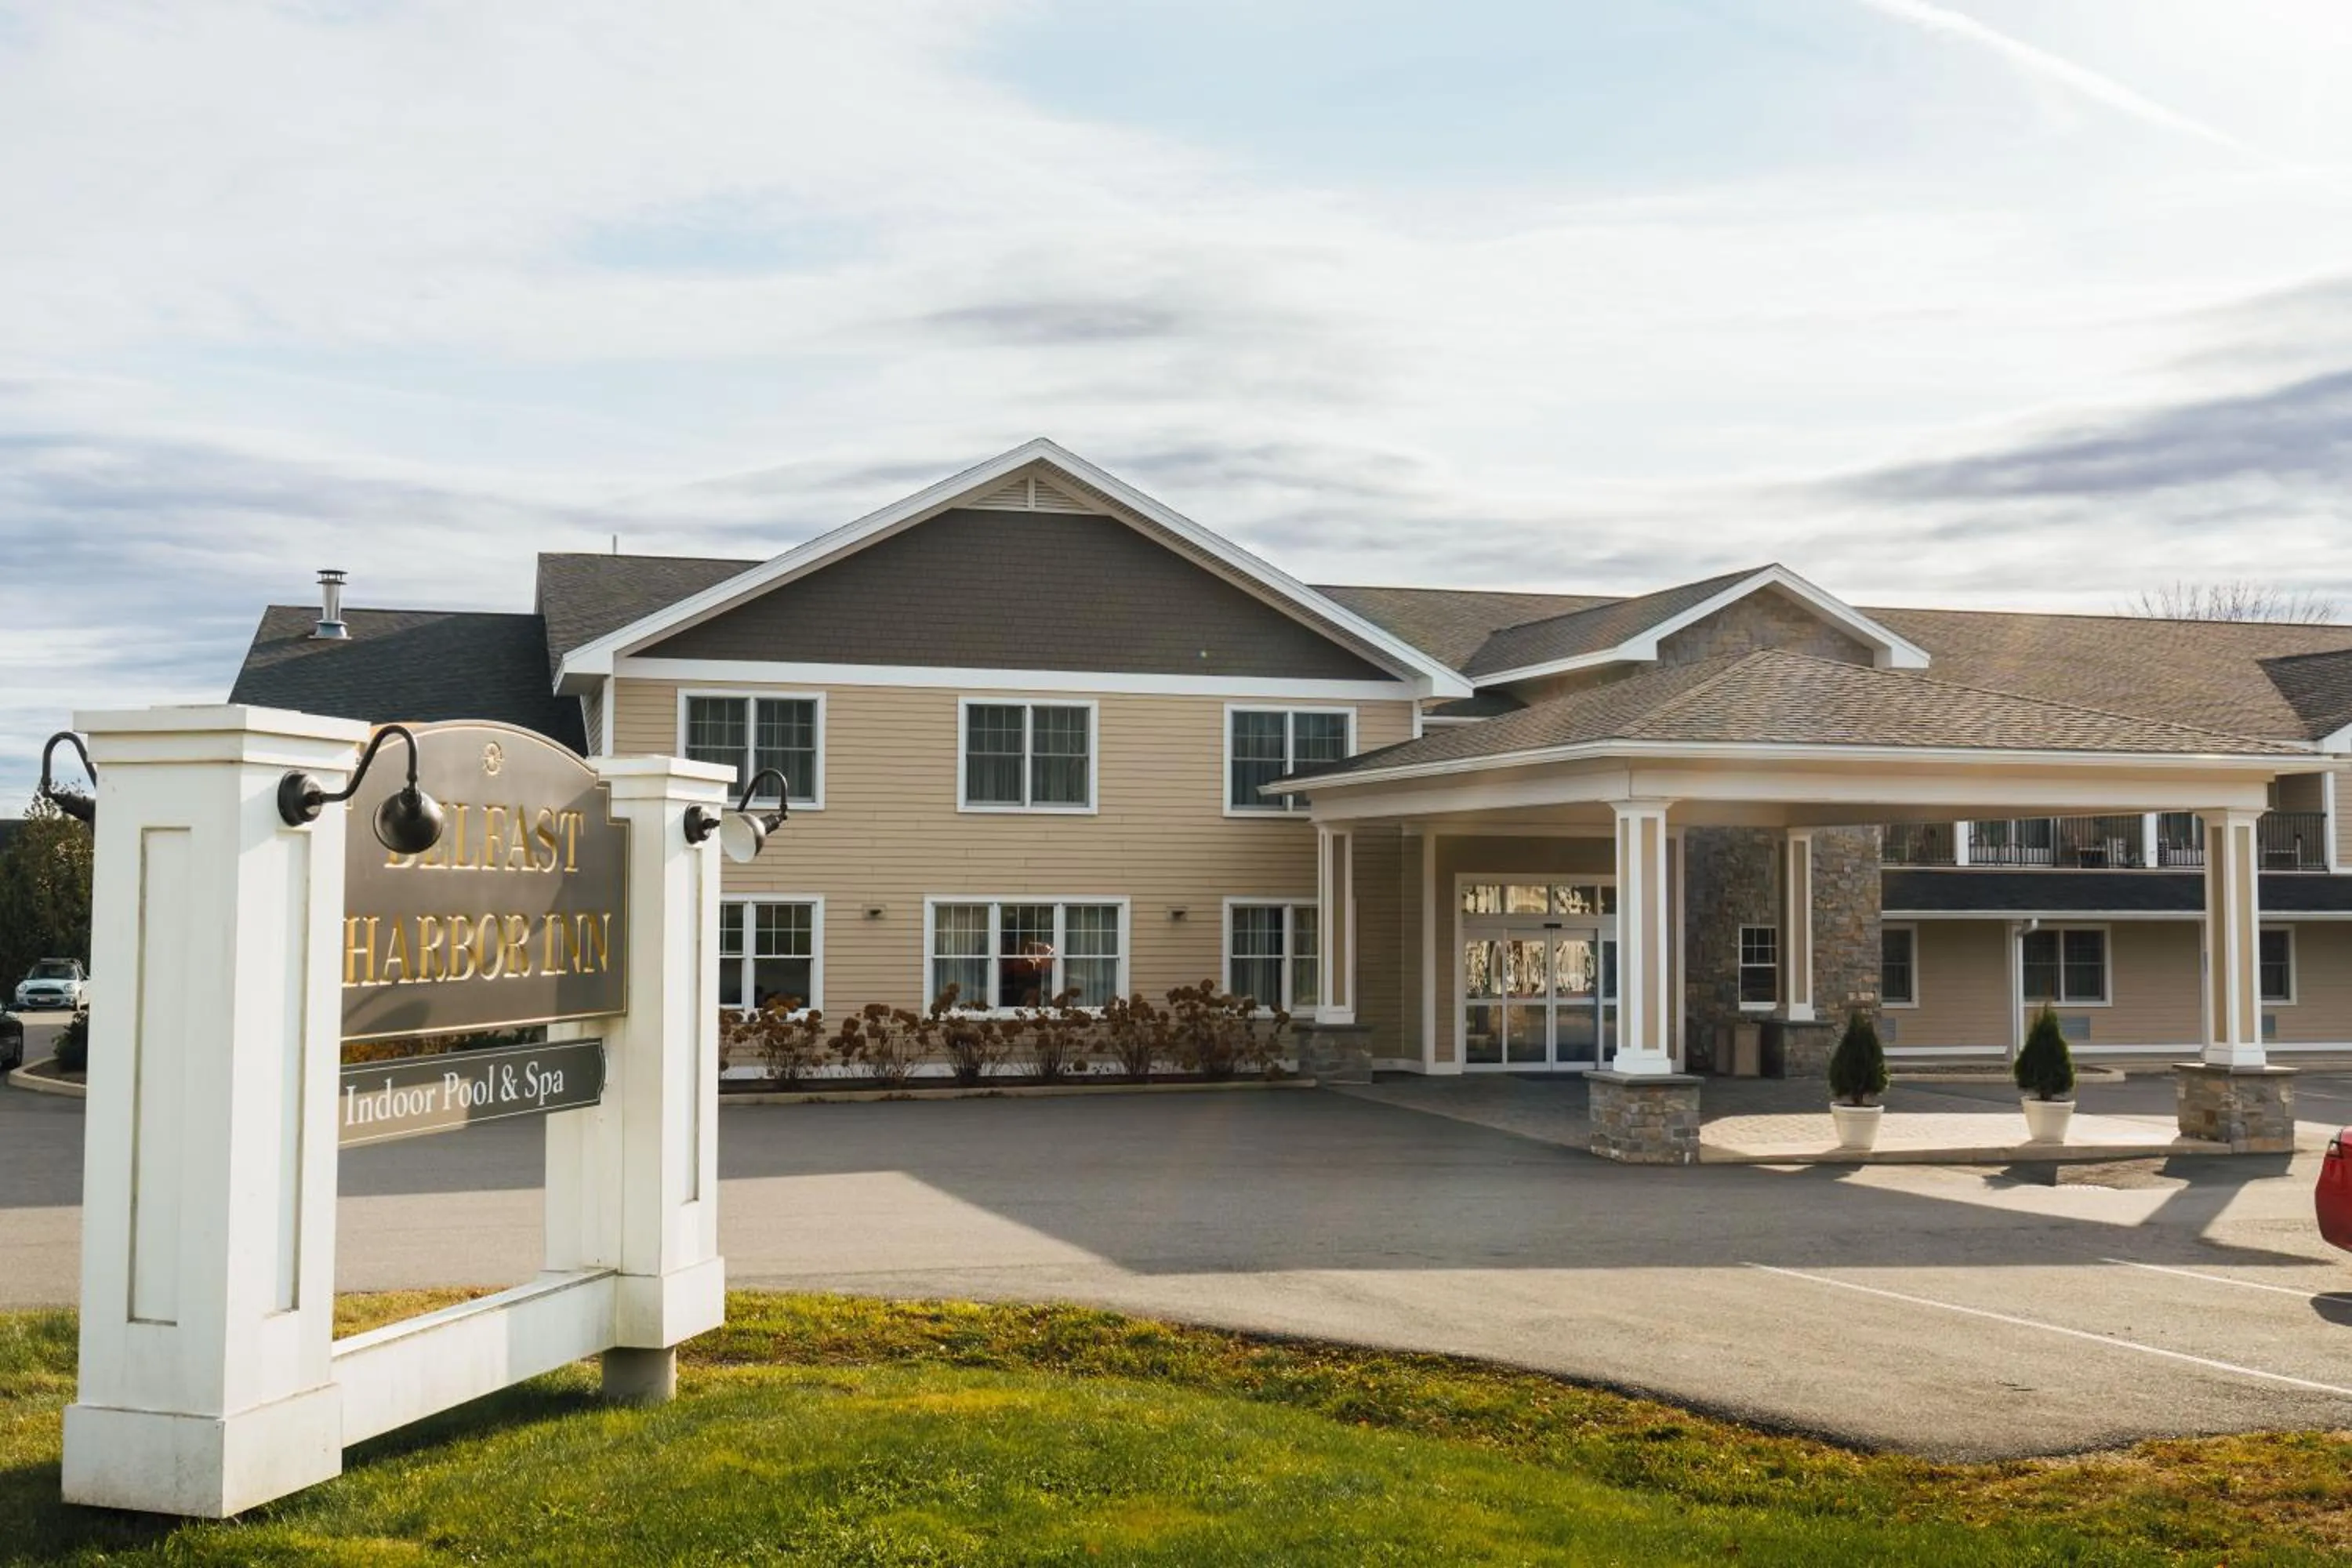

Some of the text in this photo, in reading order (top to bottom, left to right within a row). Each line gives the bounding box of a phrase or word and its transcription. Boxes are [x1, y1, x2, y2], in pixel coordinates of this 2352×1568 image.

[383, 802, 585, 873] LFAST
[342, 912, 612, 987] HARBOR INN
[345, 1061, 565, 1126] Indoor Pool & Spa
